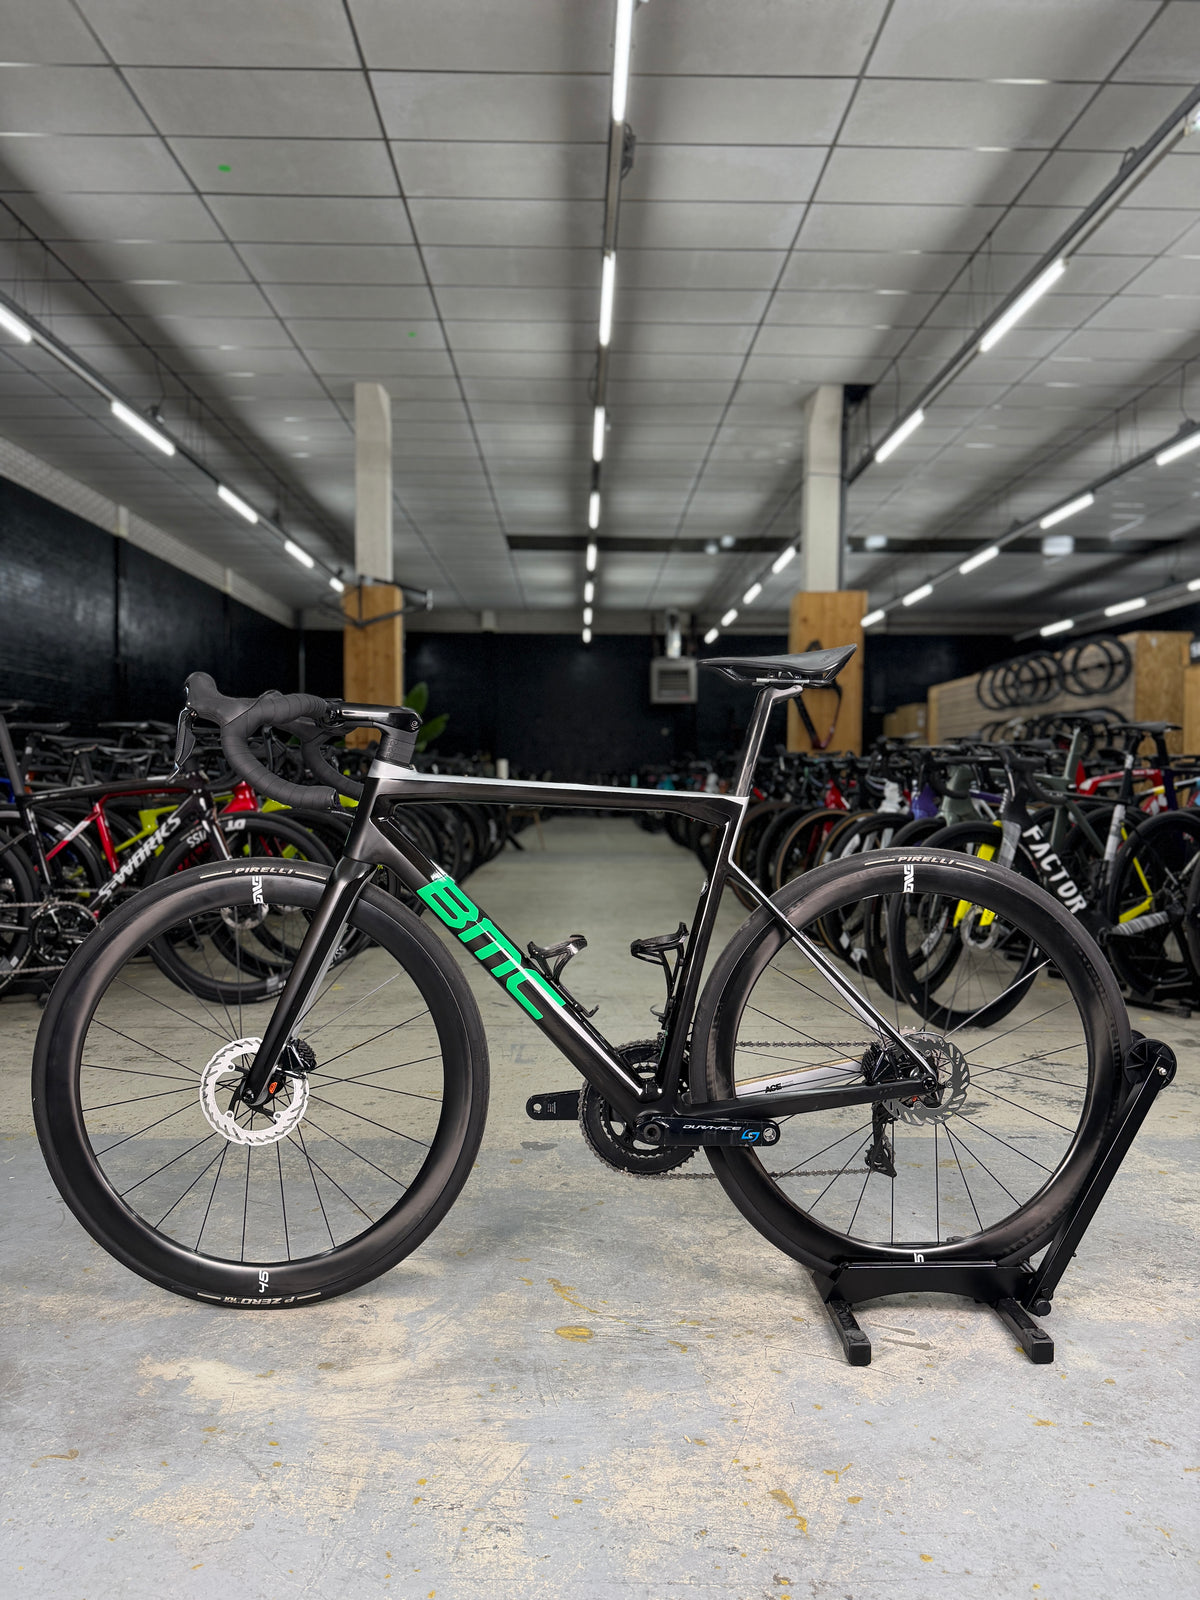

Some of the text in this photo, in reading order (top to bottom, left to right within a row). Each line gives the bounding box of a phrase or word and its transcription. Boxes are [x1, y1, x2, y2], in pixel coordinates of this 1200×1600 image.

[98, 818, 181, 903] S-WORKS
[1022, 825, 1087, 914] FACTOR
[417, 876, 566, 1020] BMC
[241, 1297, 282, 1305] ZERO
